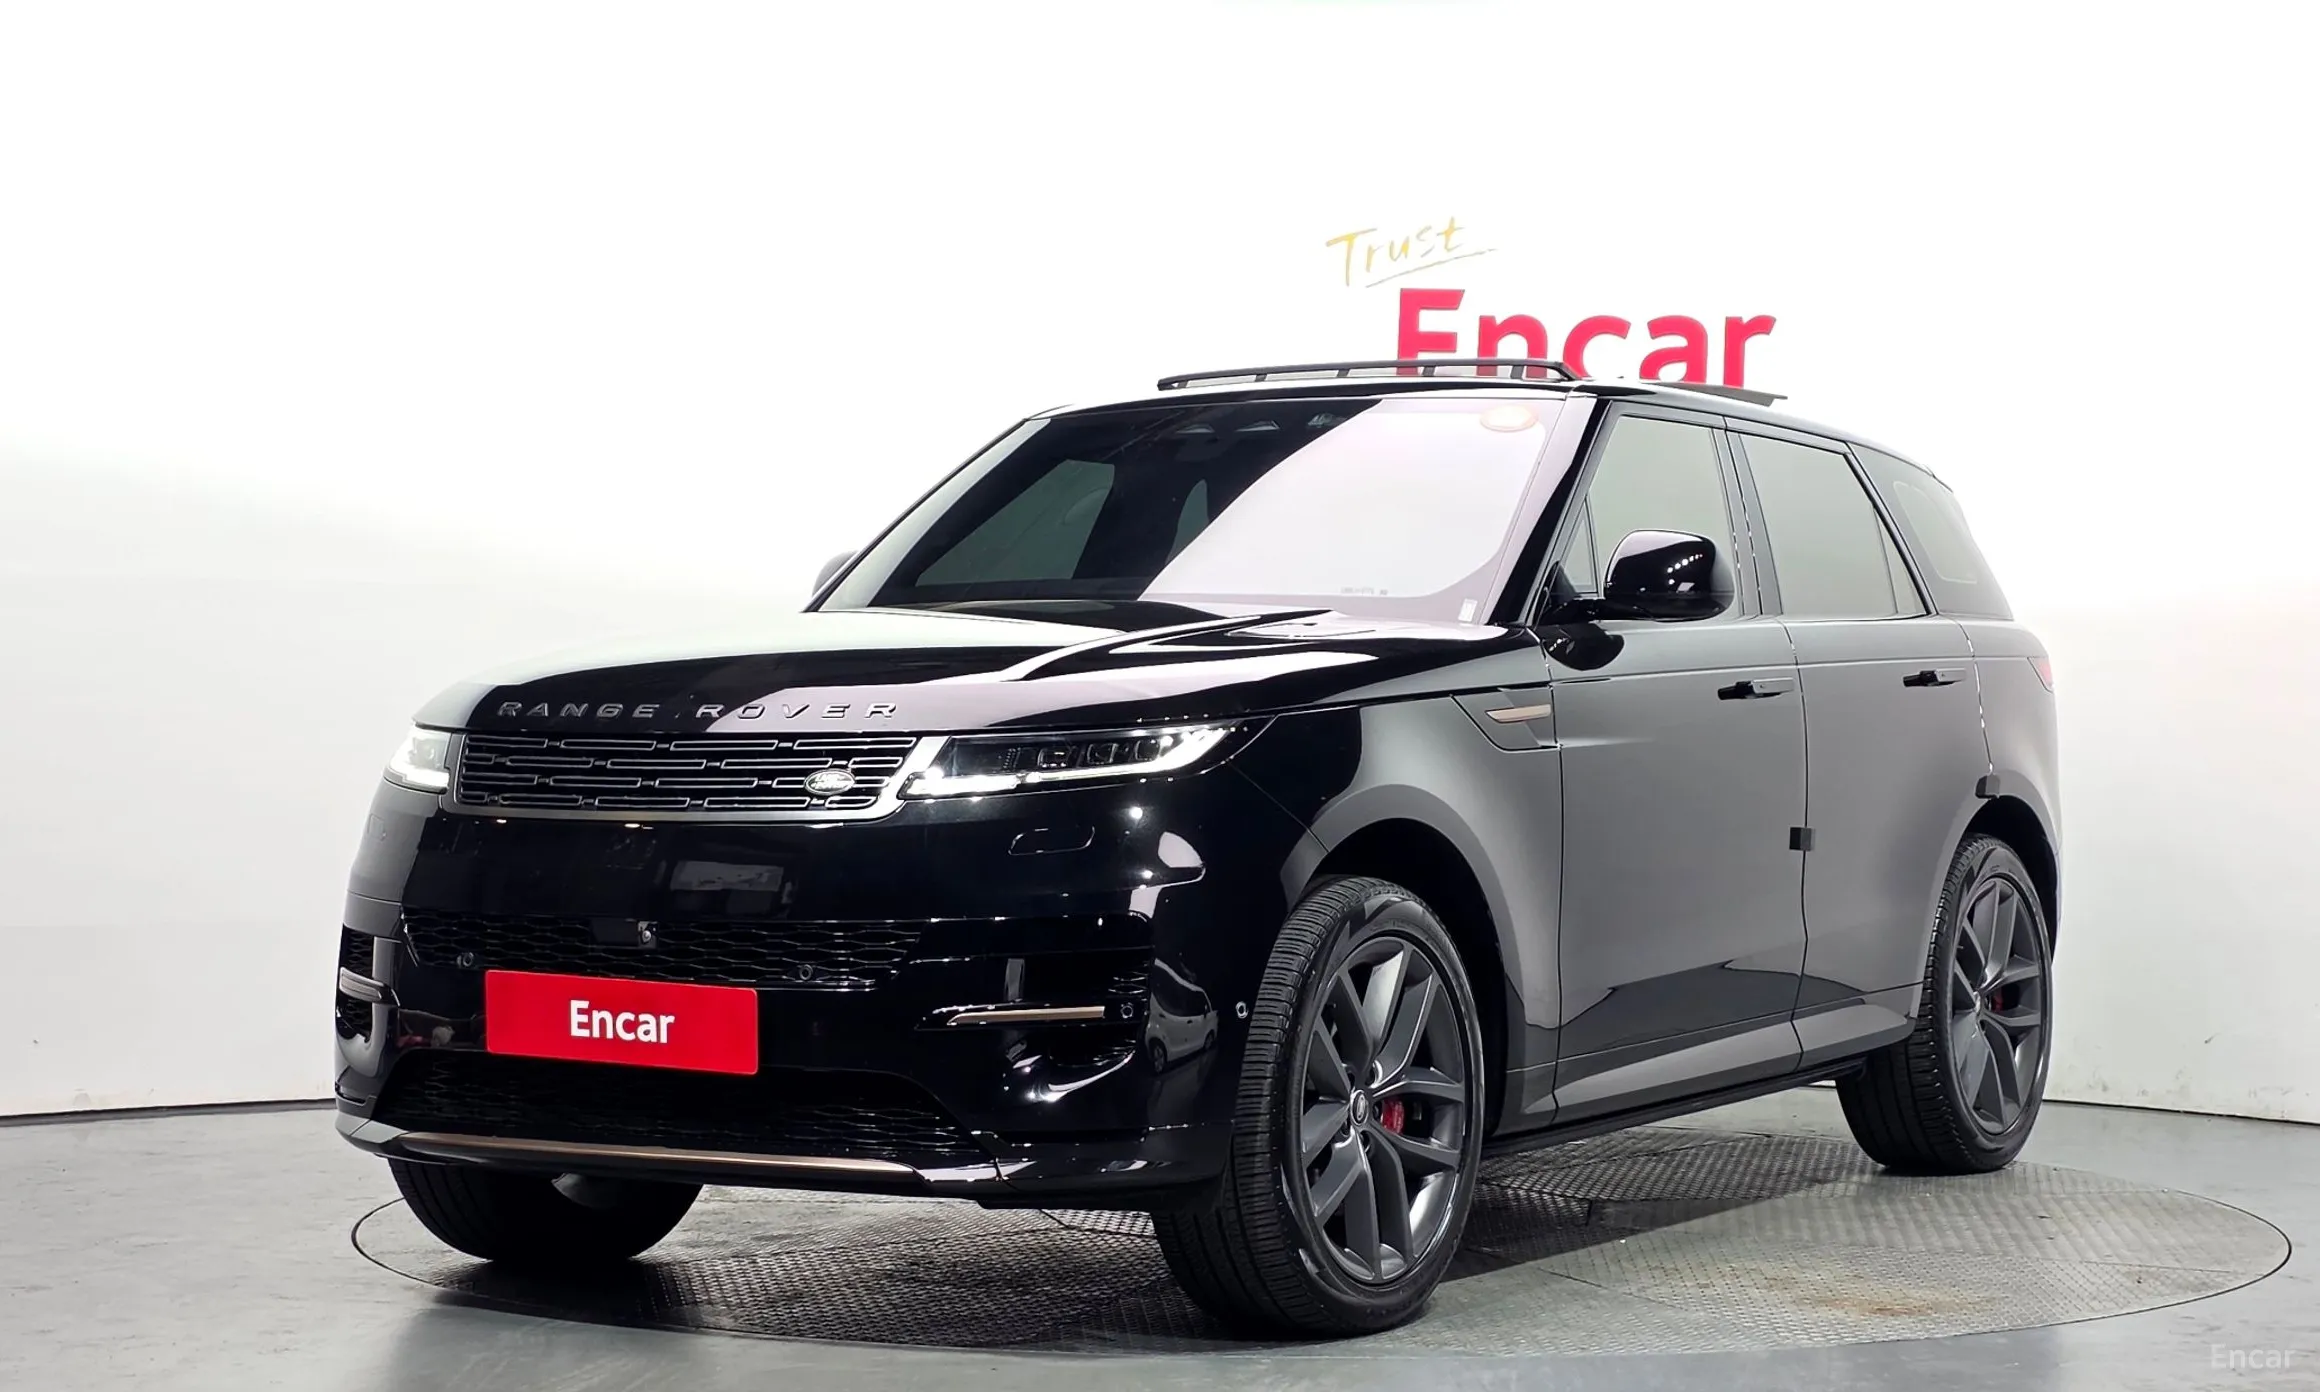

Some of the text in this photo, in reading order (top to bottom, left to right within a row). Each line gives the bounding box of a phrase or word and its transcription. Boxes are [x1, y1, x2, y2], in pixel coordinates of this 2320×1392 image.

[1327, 217, 1465, 287] Trust
[1397, 288, 1777, 388] Encar
[496, 702, 899, 720] RANGE ROVER
[570, 1000, 675, 1043] Encar
